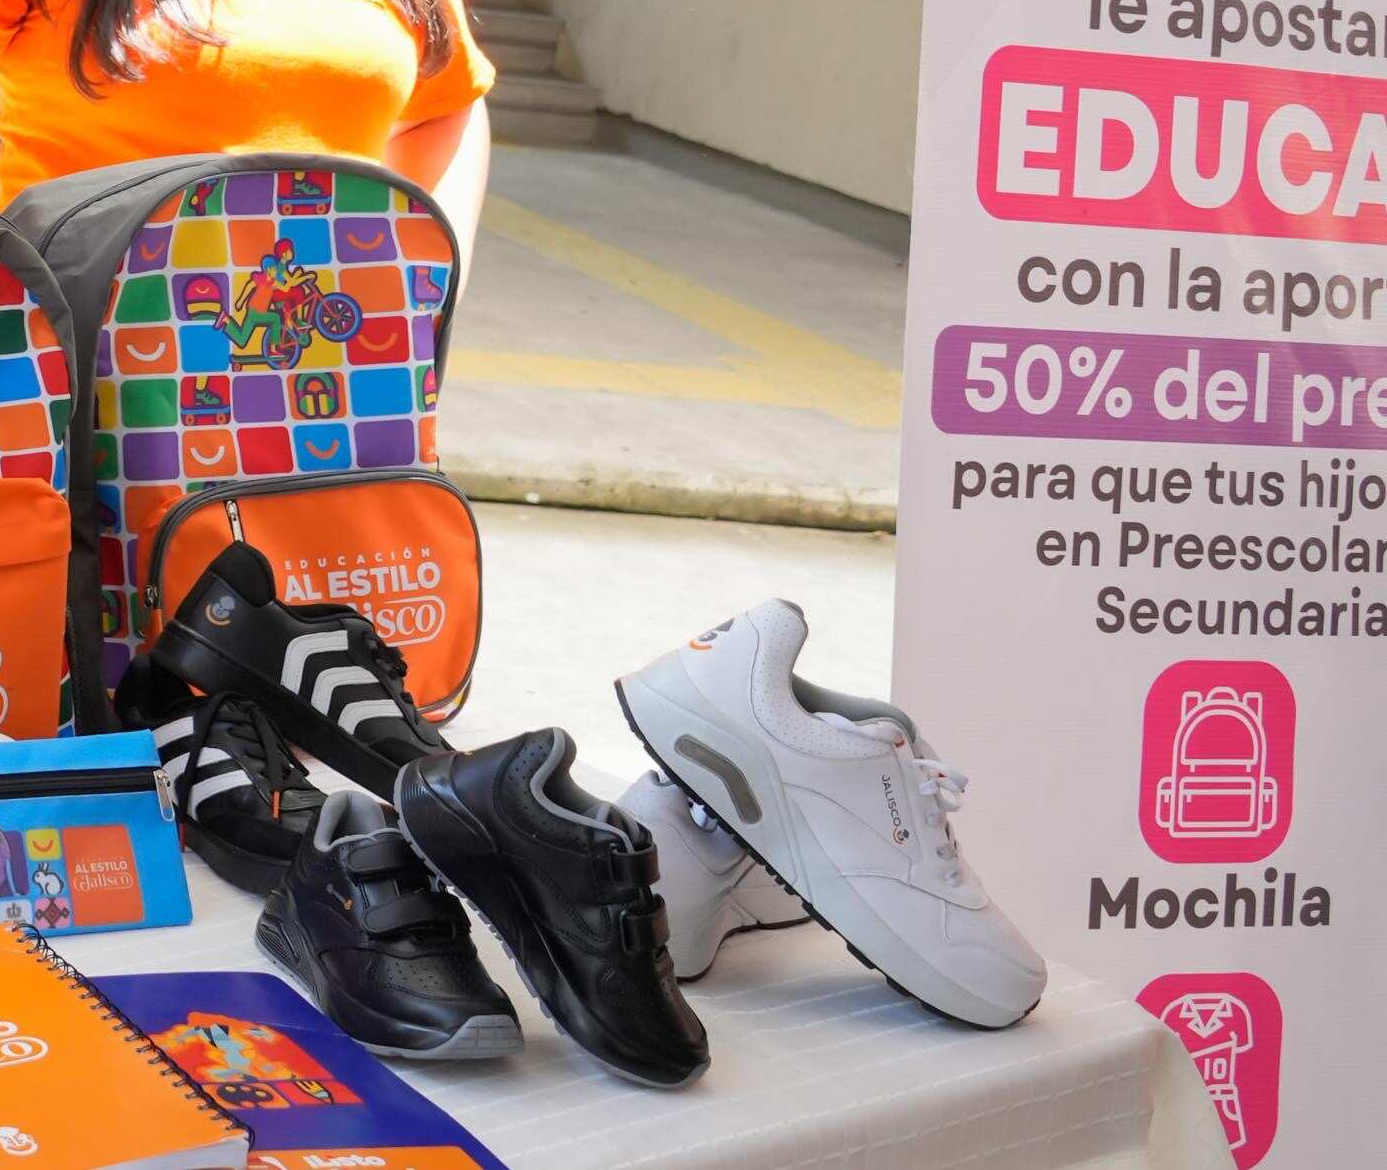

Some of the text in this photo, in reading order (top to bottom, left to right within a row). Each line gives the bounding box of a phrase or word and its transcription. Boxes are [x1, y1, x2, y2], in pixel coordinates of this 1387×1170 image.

[995, 81, 1387, 217] EDUCA
[1017, 247, 1387, 332] con la apor
[964, 342, 1133, 419] 50%
[1153, 349, 1271, 424] del
[952, 458, 1387, 522] para que tus hijo
[284, 547, 430, 571] EDUCACIÓN
[1036, 522, 1387, 573] en Preescolar
[284, 561, 441, 603] AL ESTILO
[1096, 586, 1387, 637] Secundaria
[882, 773, 901, 827] JALISCO
[75, 860, 128, 874] AL ESTILO
[1088, 867, 1331, 930] Mochila
[1203, 1057, 1227, 1080] 10
